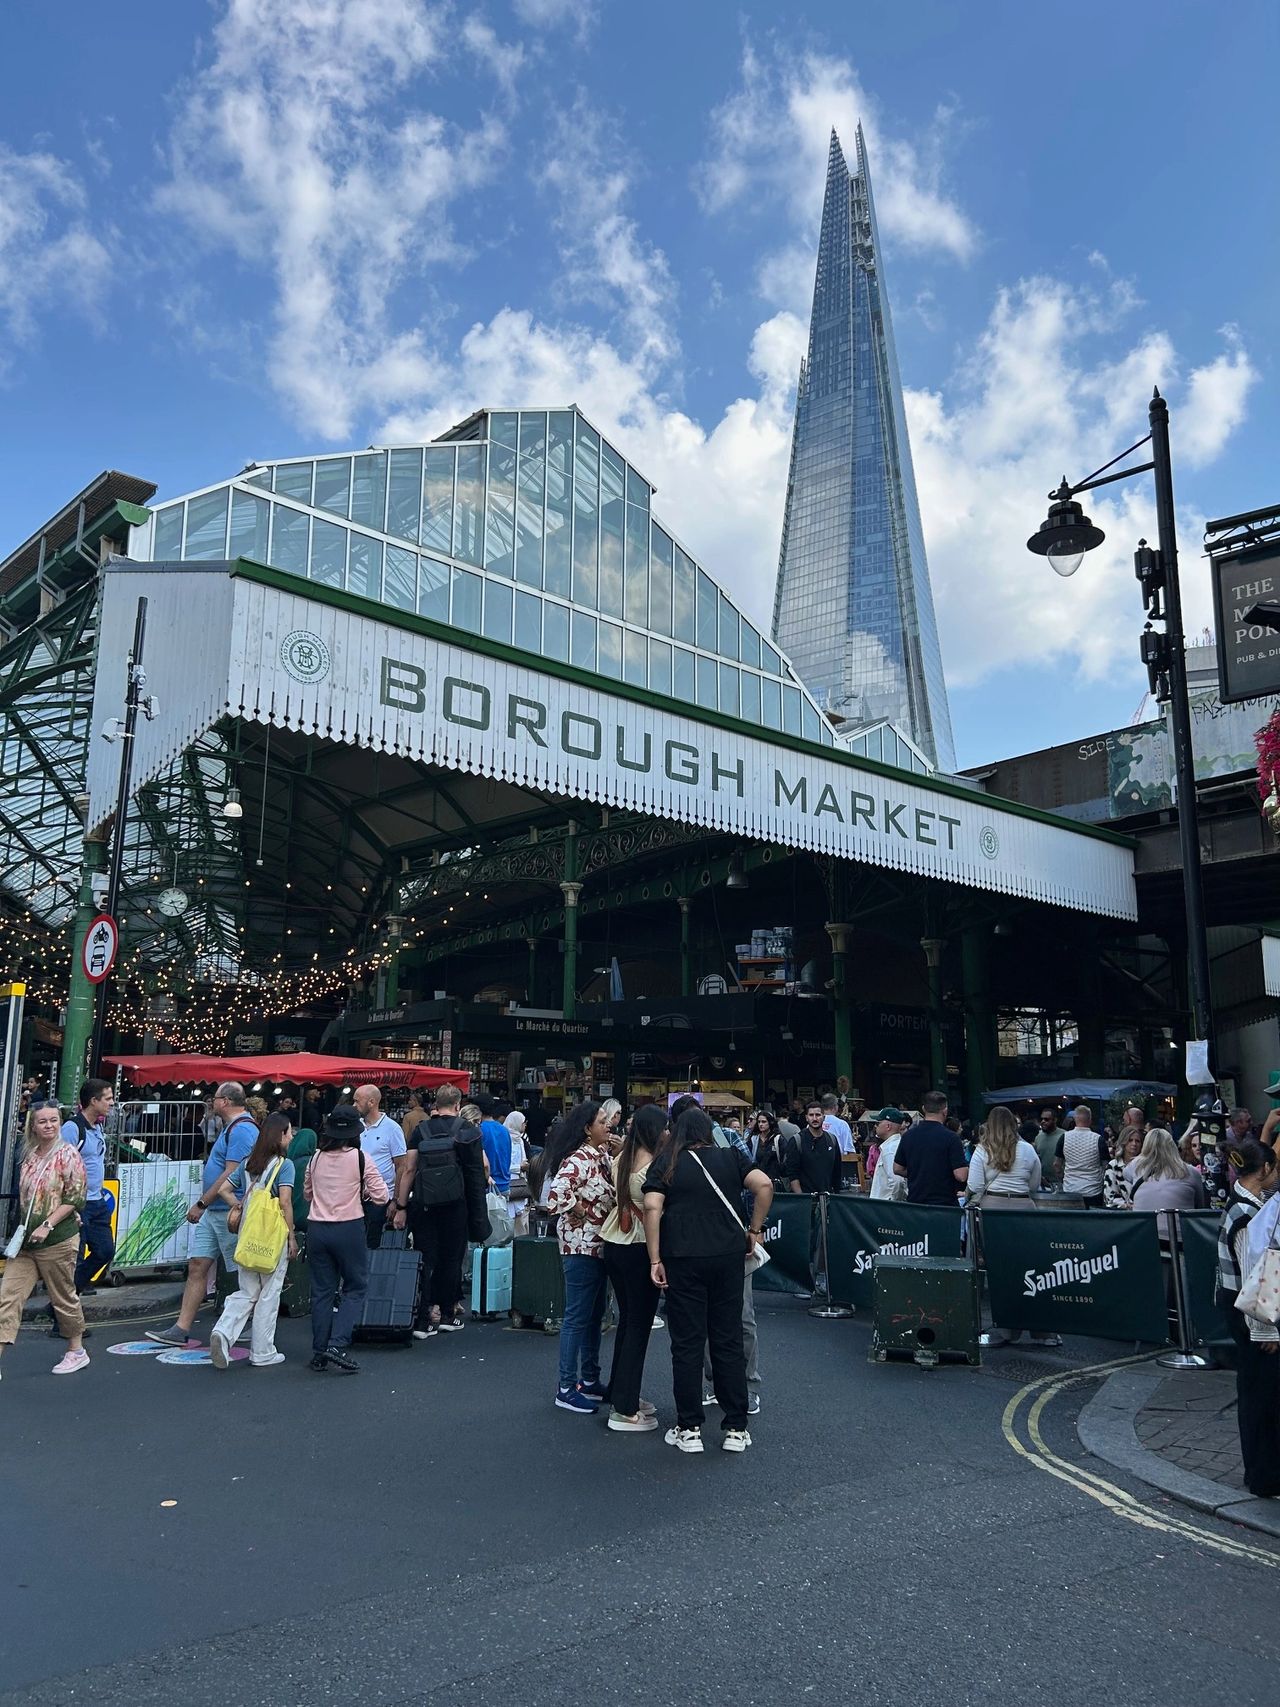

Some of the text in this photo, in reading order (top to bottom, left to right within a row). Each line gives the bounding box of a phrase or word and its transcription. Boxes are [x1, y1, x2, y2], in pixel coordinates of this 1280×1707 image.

[1231, 577, 1275, 601] THE
[1236, 653, 1256, 665] PUB
[1257, 651, 1267, 660] &
[379, 655, 962, 851] BOROUGH MARKET
[1077, 737, 1115, 761] SIDE
[516, 1019, 590, 1035] Le Marché du Quartier
[121, 1168, 129, 1209] Asparagus
[1049, 1241, 1085, 1250] CERVEZAS
[1051, 1294, 1094, 1304] SINCE 1890
